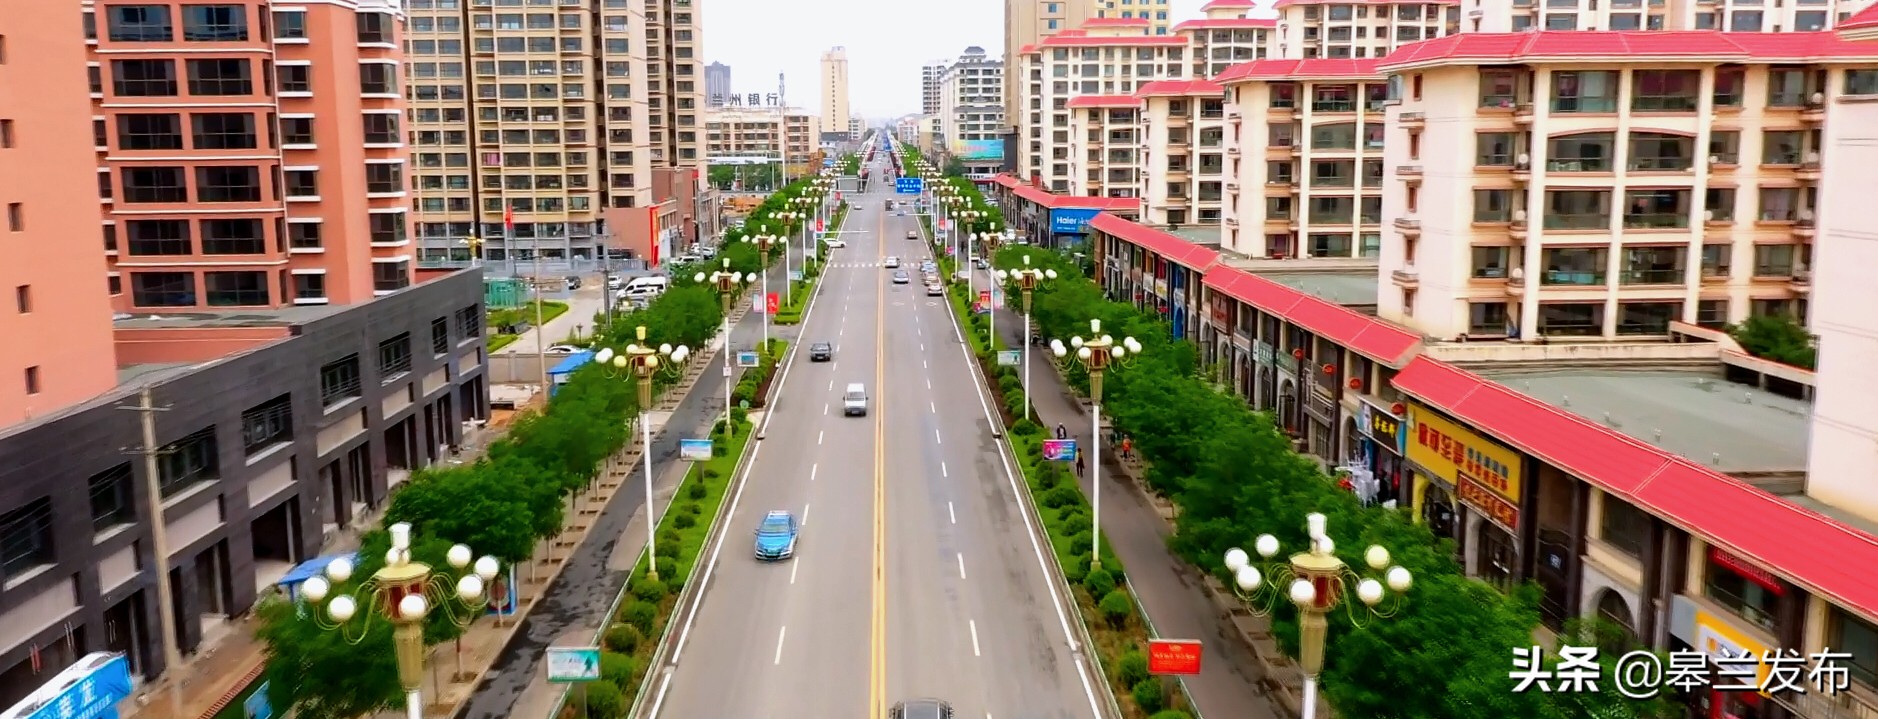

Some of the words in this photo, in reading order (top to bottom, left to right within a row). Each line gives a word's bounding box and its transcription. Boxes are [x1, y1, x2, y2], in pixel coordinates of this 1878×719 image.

[711, 92, 779, 106] 兰州银行
[1056, 216, 1077, 225] Haier
